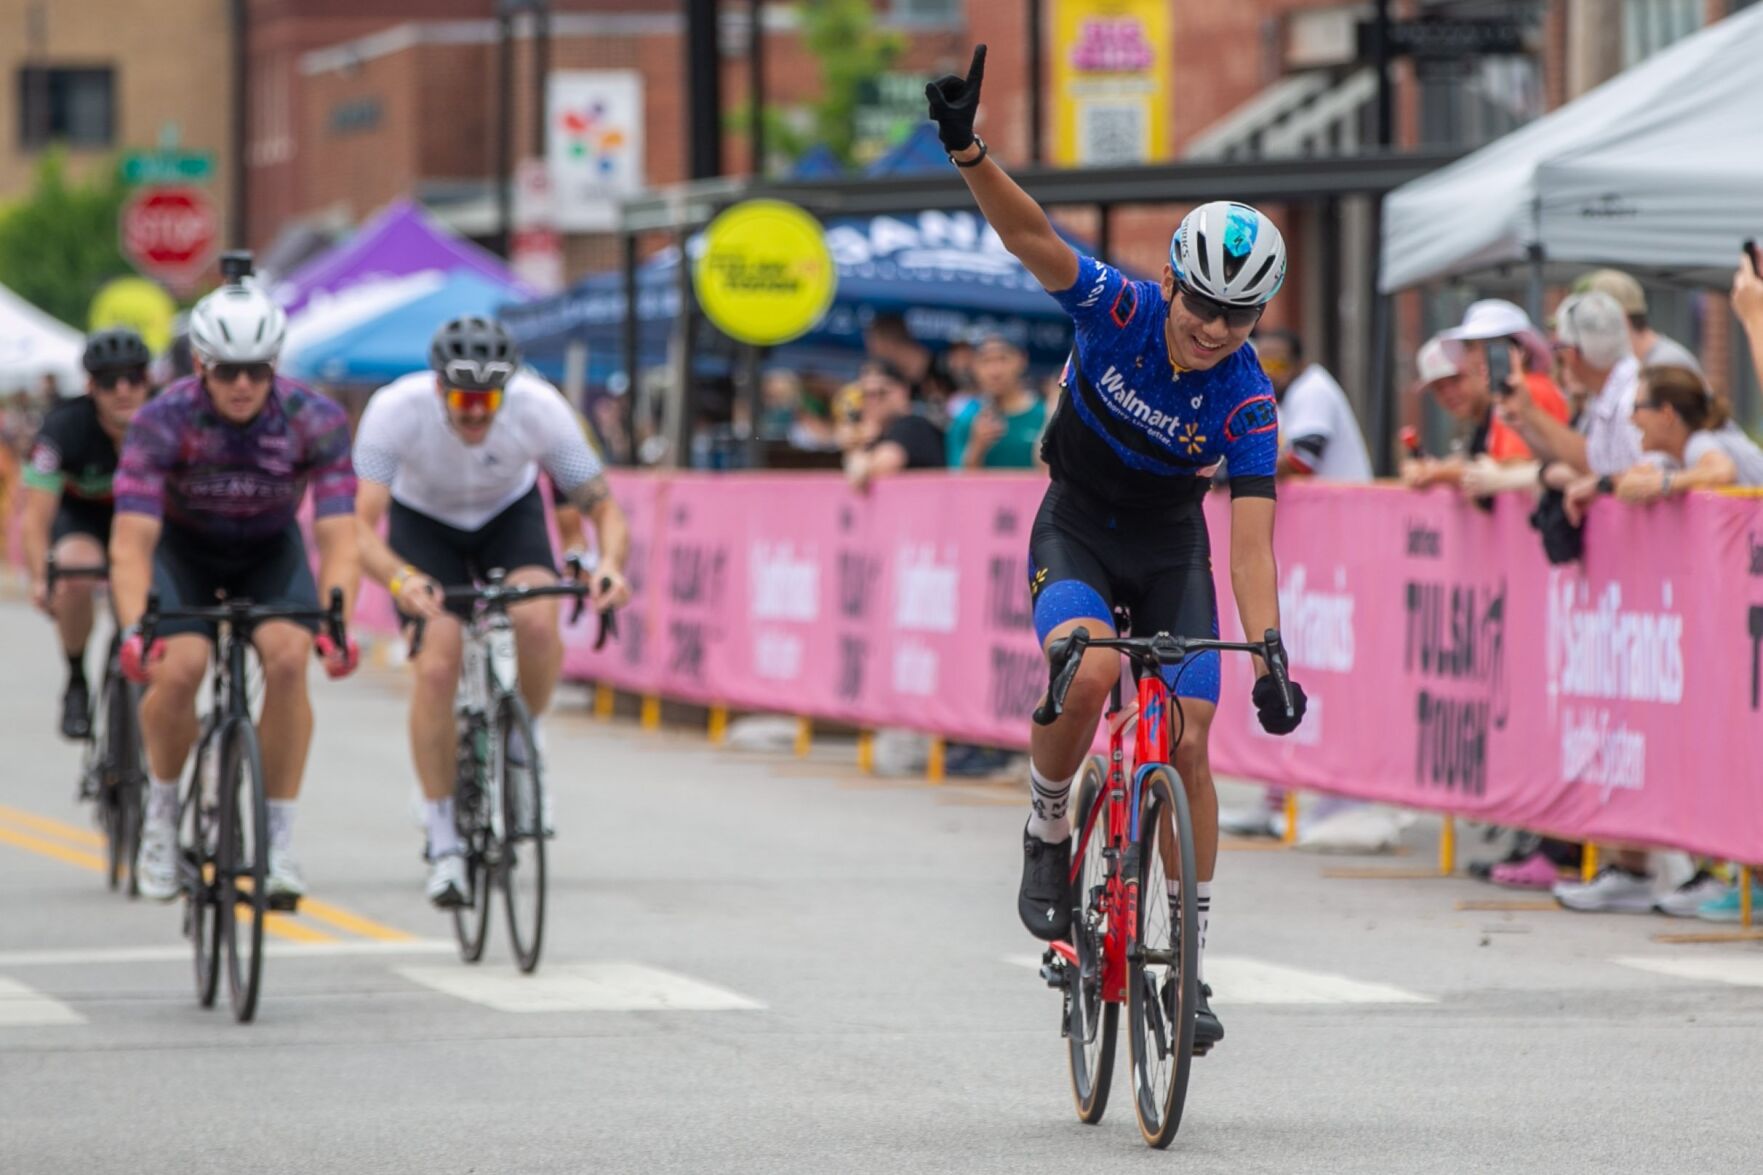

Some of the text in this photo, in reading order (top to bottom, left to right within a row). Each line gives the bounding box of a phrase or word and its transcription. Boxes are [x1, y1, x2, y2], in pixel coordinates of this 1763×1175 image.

[128, 208, 214, 250] STOP
[1100, 365, 1181, 438] Walmart
[1404, 581, 1478, 677] TULSA
[1416, 688, 1489, 797] TOUGH
